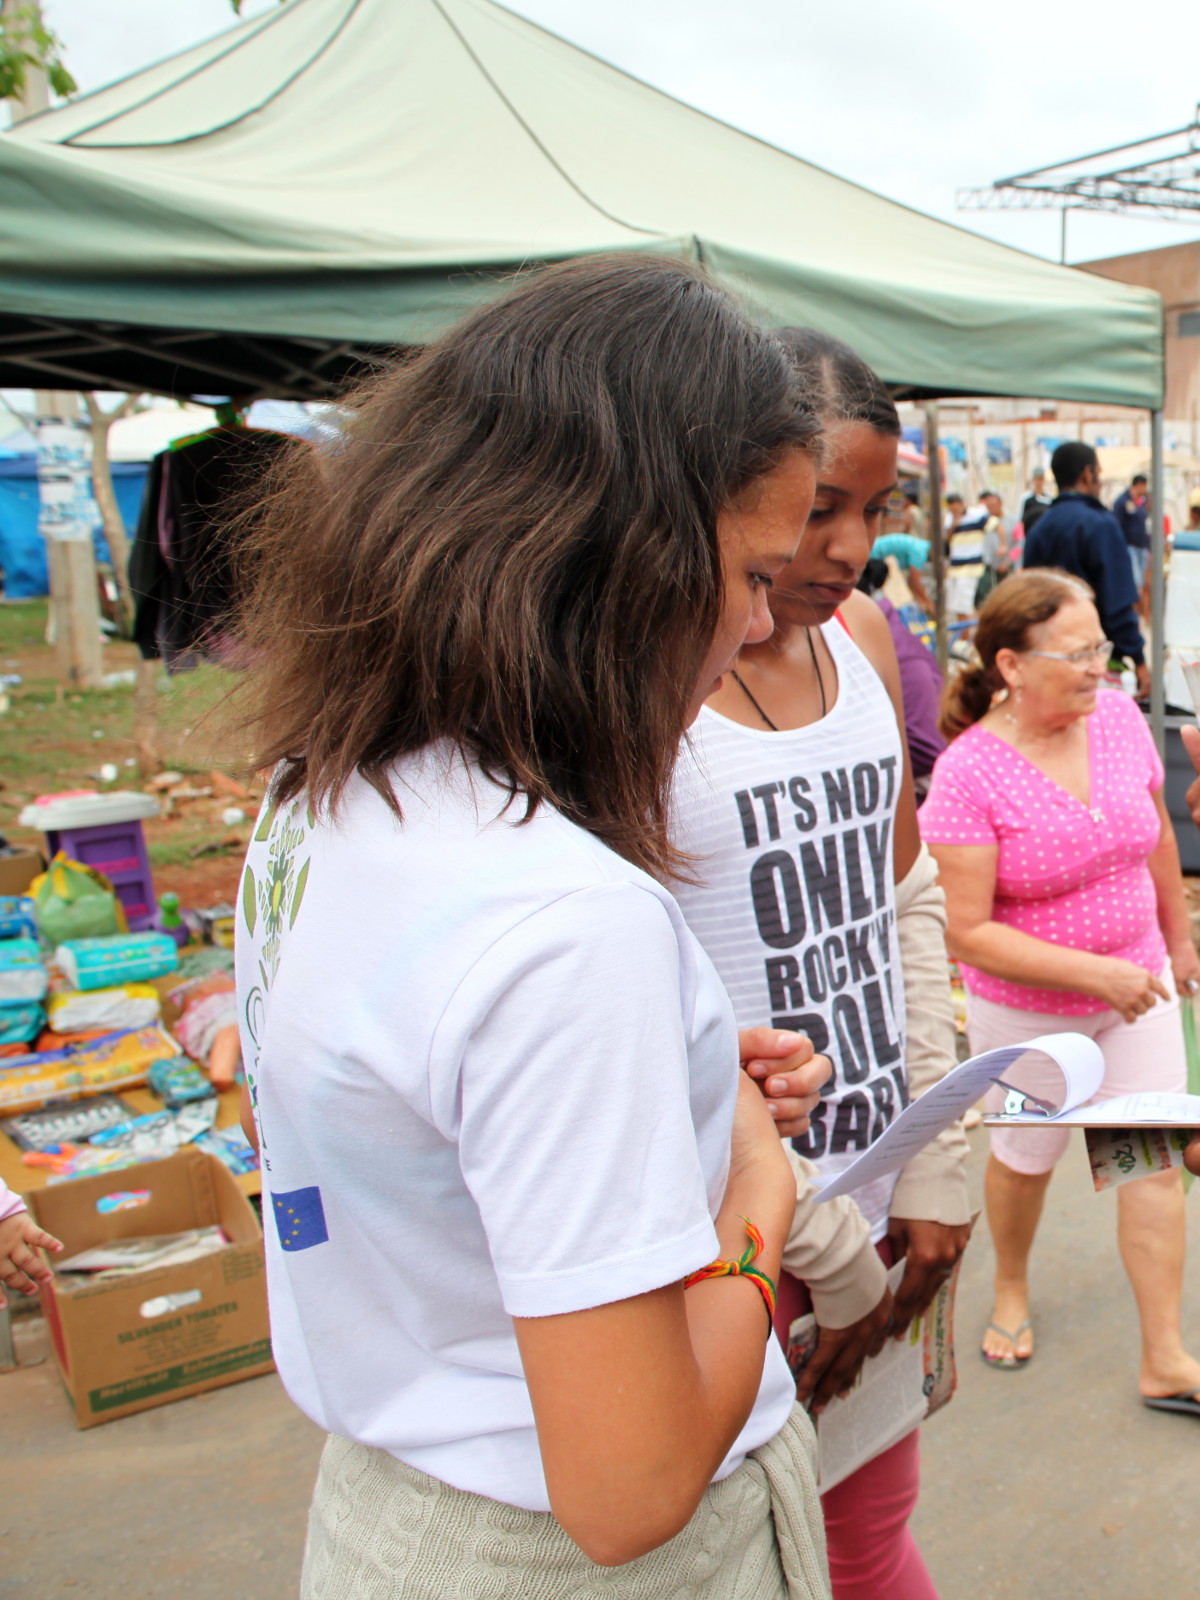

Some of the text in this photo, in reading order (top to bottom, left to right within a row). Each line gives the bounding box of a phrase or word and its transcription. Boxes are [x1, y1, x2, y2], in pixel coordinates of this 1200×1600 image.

[734, 755, 897, 849] IT'S NOT
[750, 817, 892, 949] ONLY
